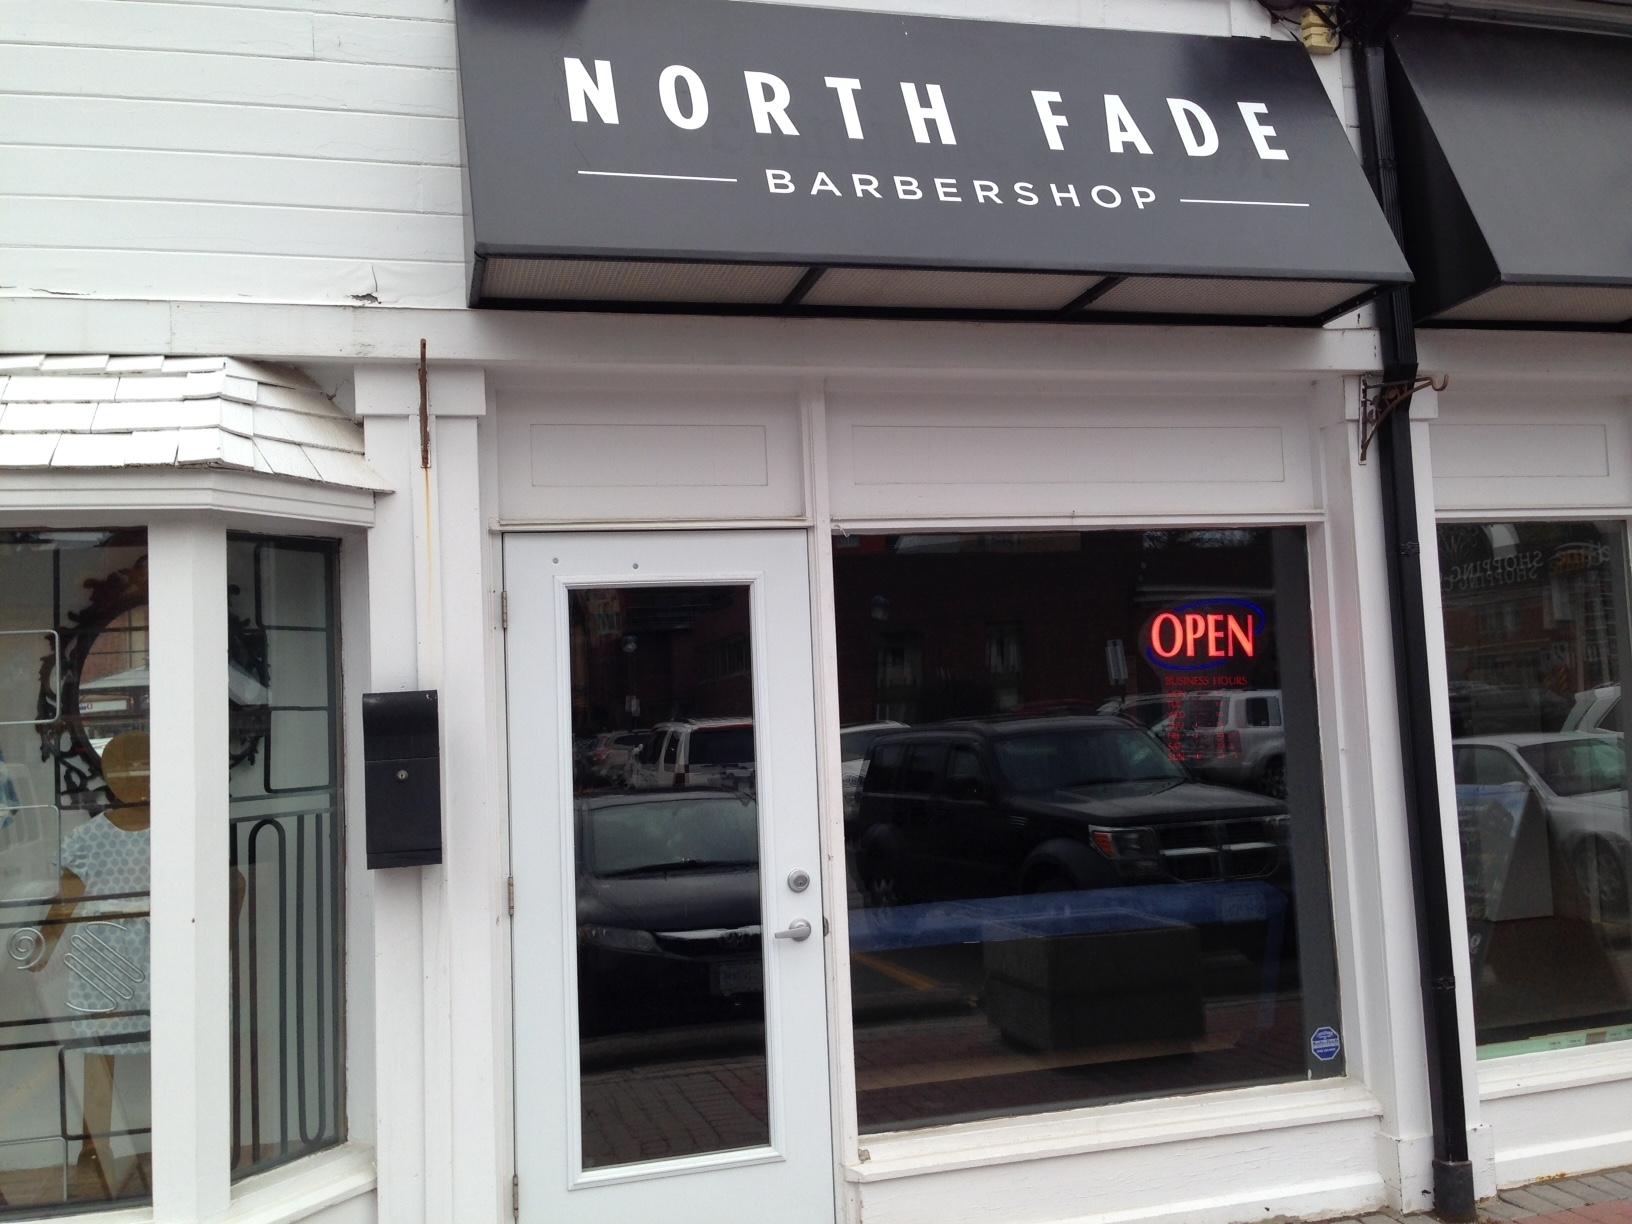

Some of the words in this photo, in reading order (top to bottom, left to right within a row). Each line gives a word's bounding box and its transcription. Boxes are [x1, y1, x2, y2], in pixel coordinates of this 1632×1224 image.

[563, 57, 957, 145] NORTH
[1031, 90, 1289, 160] FADE
[765, 169, 1156, 209] BARBERSHOP
[1151, 613, 1254, 658] OPEN
[1165, 676, 1209, 686] BUSINESS
[1213, 676, 1248, 686] HOURS
